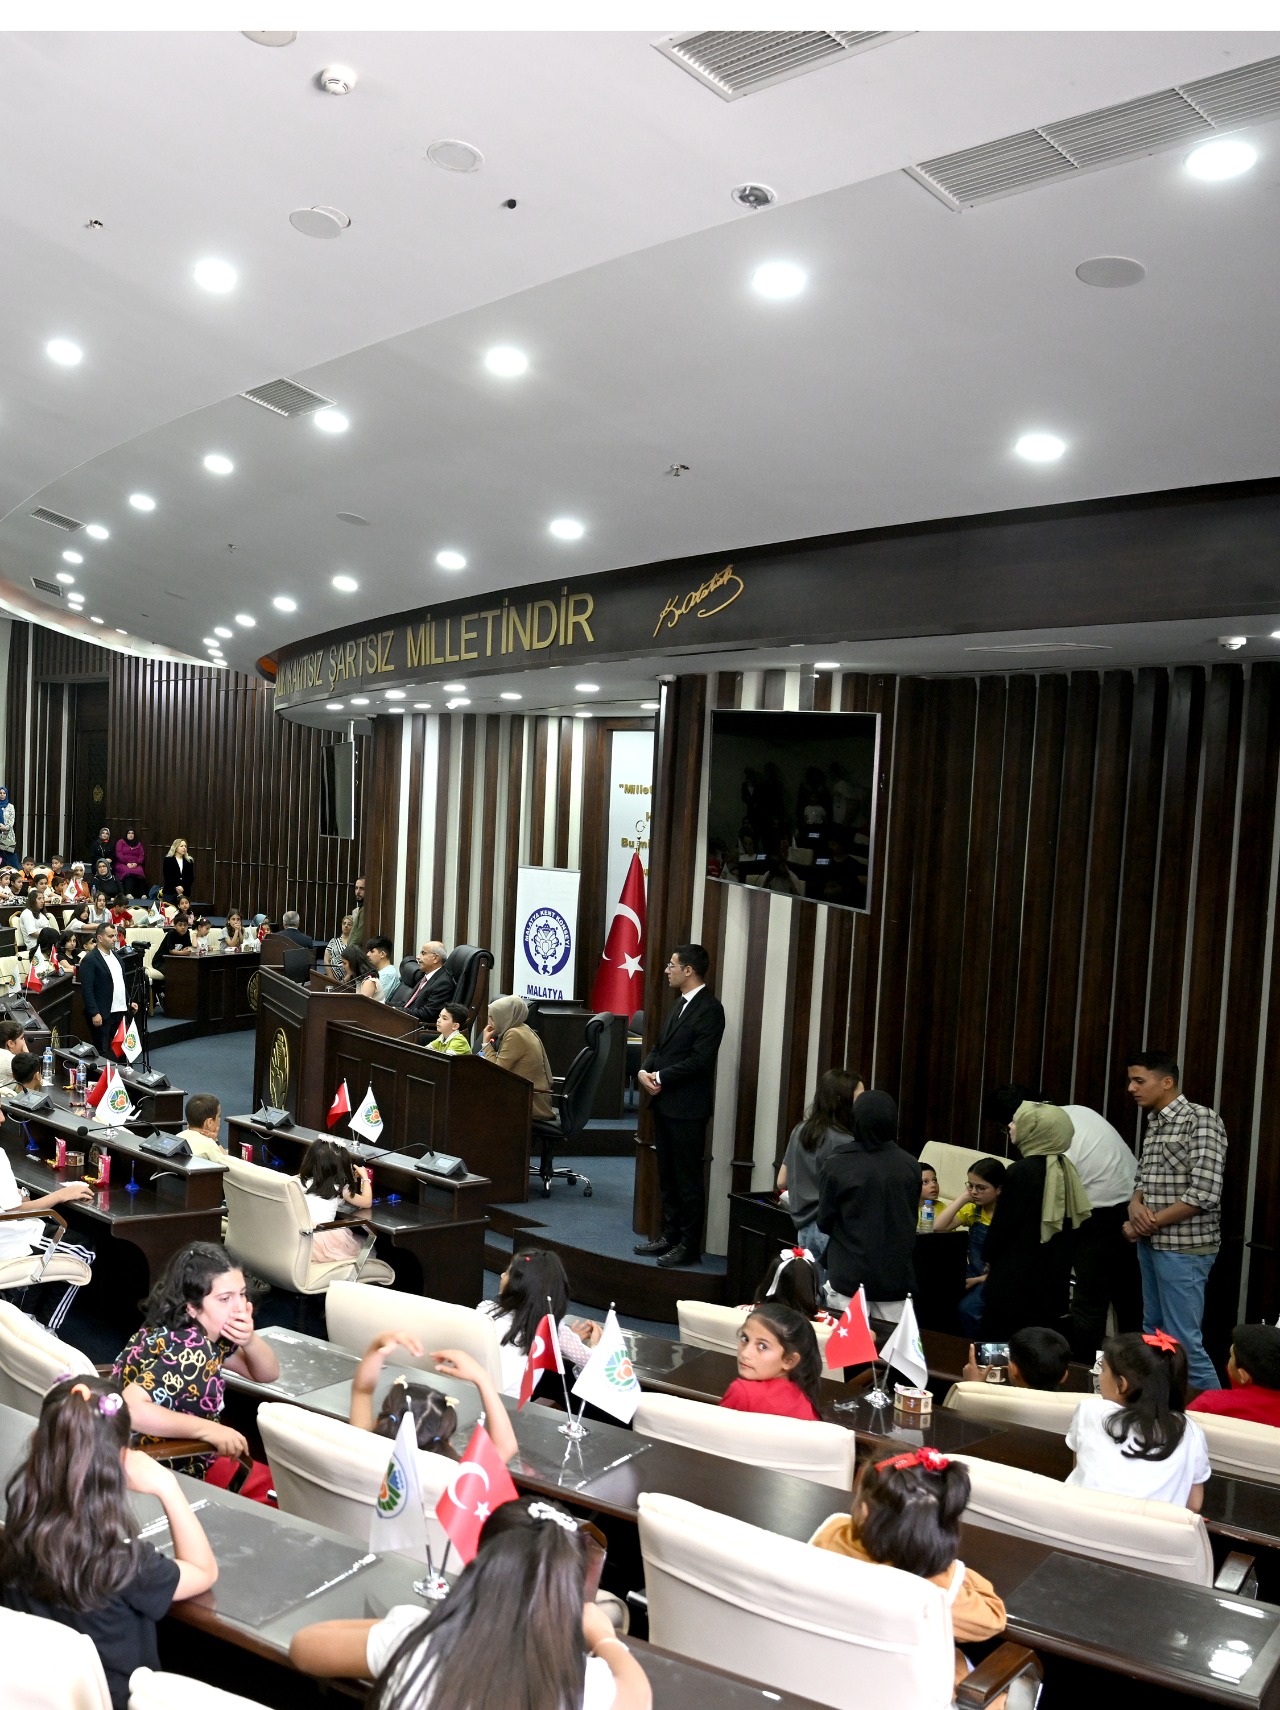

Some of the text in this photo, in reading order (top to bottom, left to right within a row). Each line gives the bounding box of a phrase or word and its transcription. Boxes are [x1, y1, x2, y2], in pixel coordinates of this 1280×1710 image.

[328, 629, 395, 692] ŞARTSIZ
[406, 585, 595, 668] MİLLETİNDİR
[527, 984, 564, 1000] MALATYA
